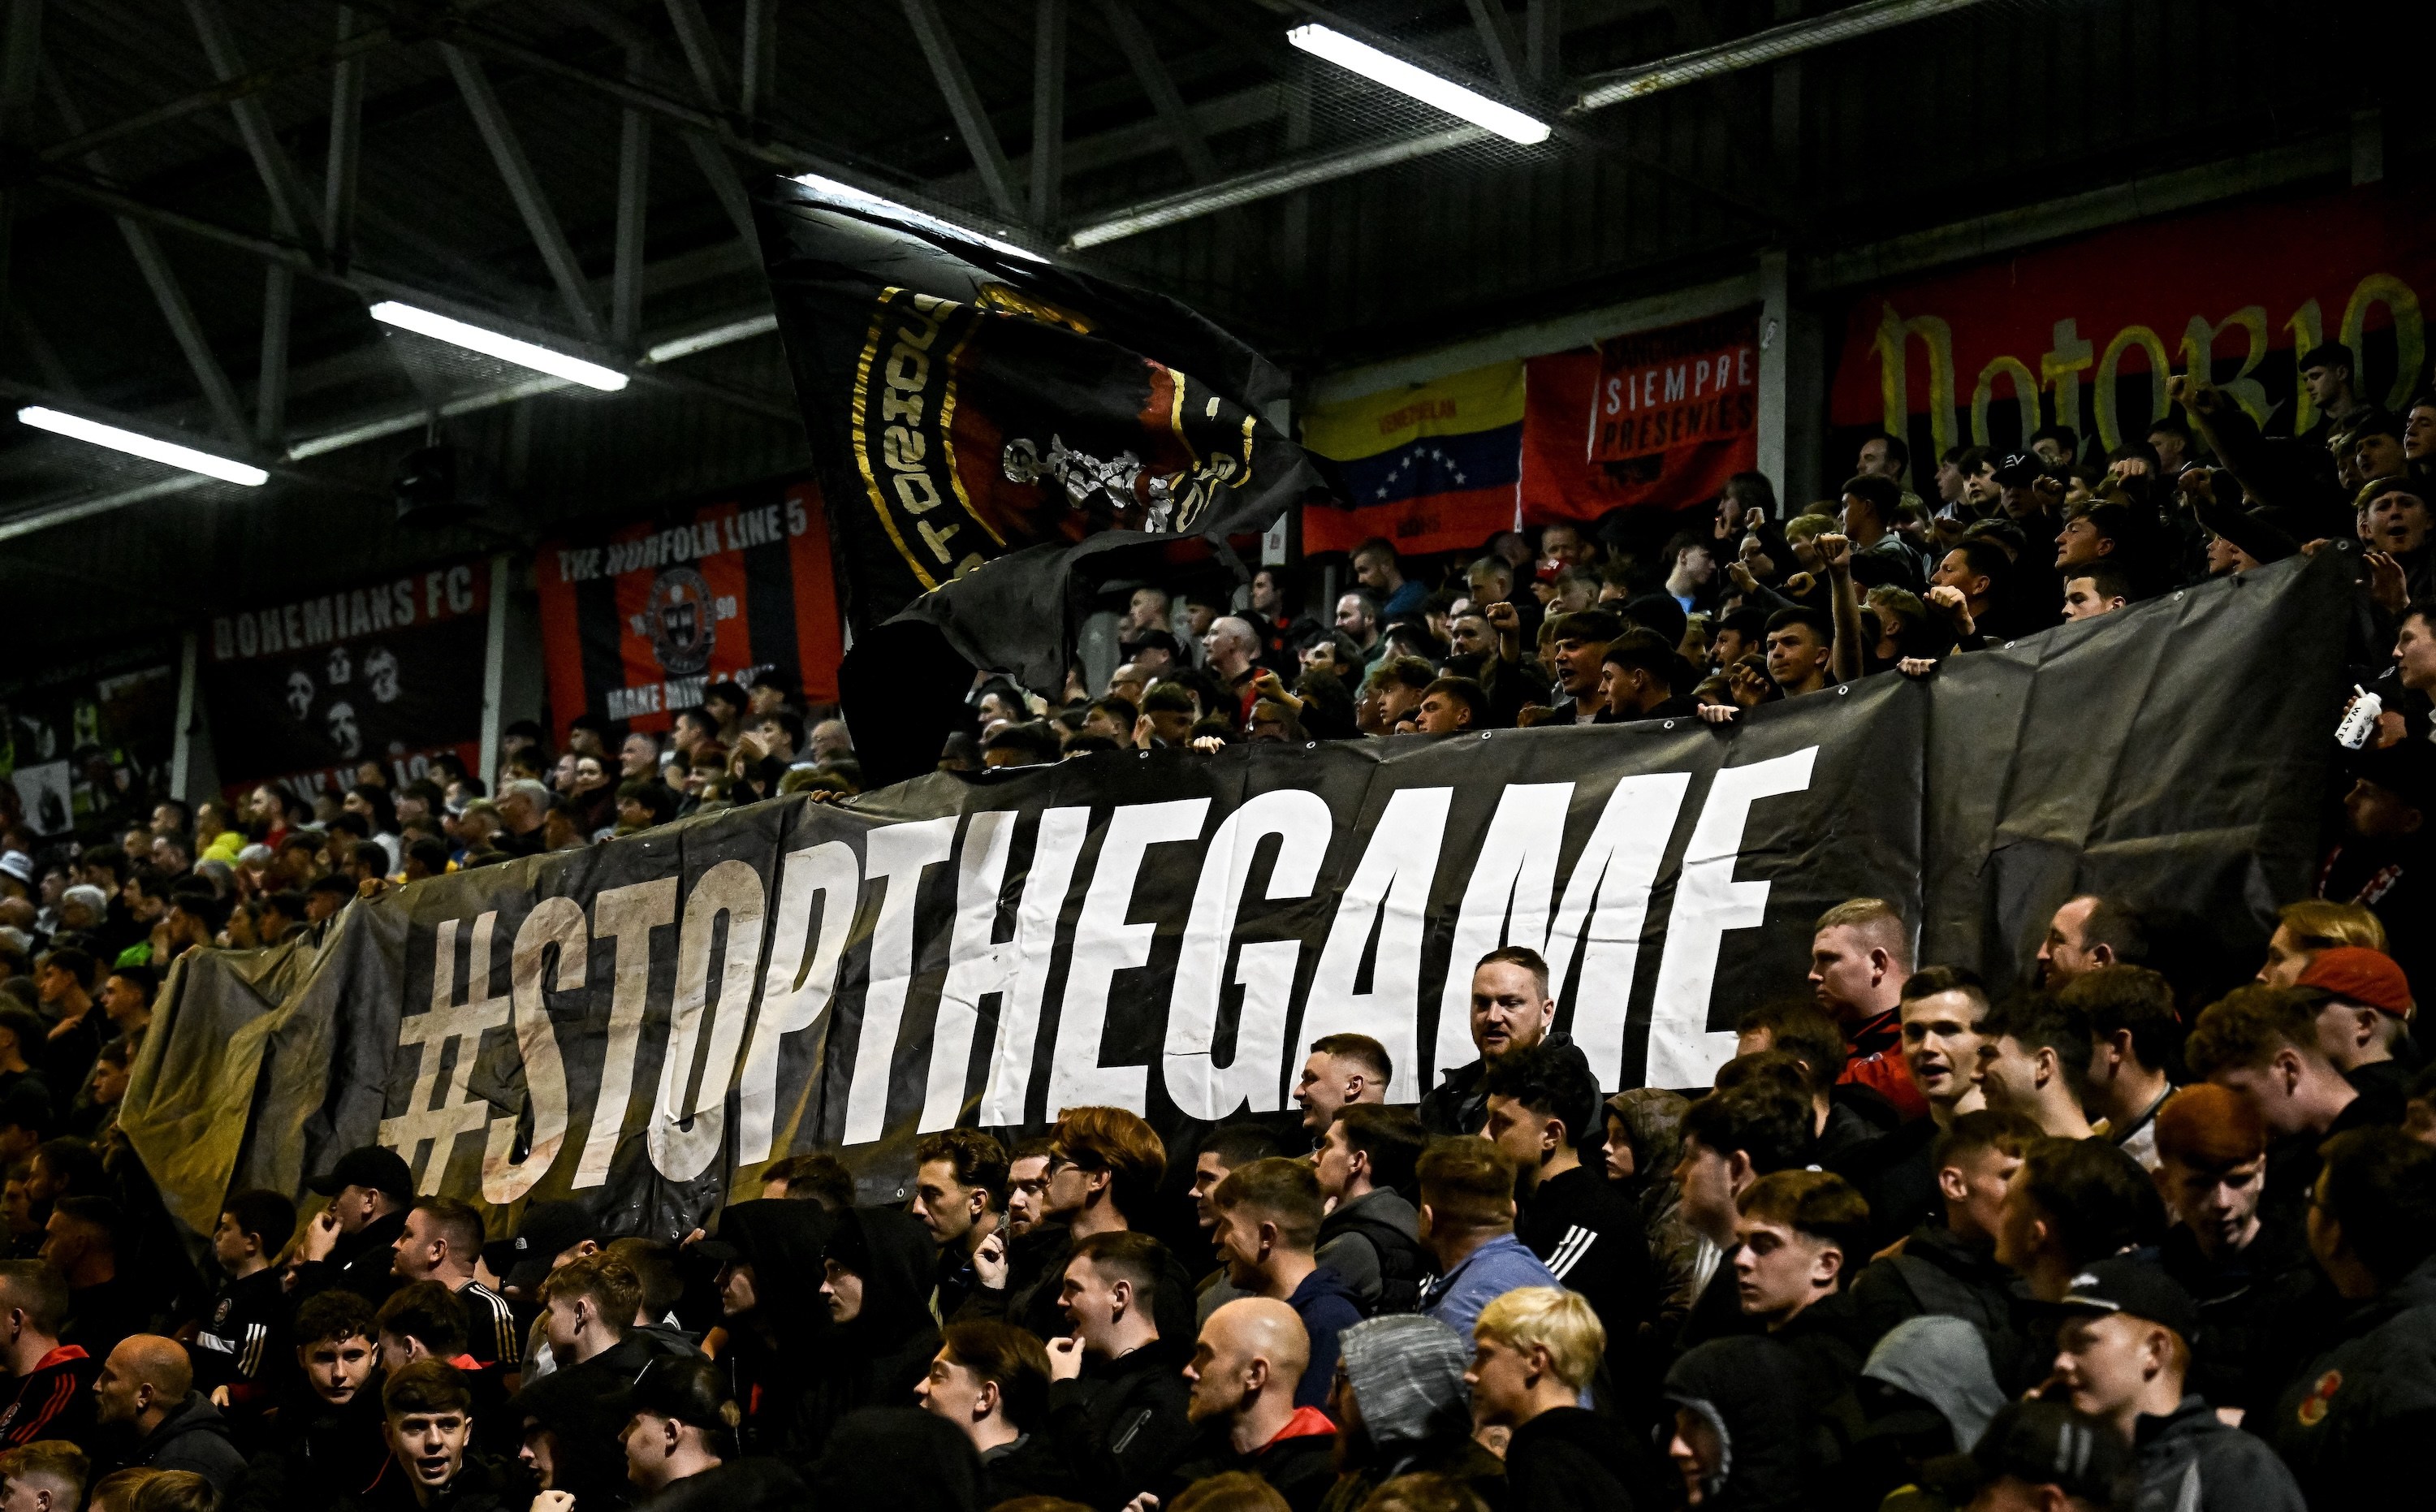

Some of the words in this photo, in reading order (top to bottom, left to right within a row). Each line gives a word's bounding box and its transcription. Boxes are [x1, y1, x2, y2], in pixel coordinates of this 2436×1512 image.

[1605, 346, 1752, 416] SIEMPRE
[1601, 392, 1754, 454] PRESENTES
[558, 547, 602, 583] THE
[603, 520, 721, 577] NORFOLK
[724, 503, 783, 552] LINE
[785, 498, 808, 537] 5
[213, 577, 417, 660] BOHEMIANS
[425, 565, 474, 620] FC
[607, 685, 661, 722] MAKE
[376, 745, 1820, 1205] #STOPTHEGAME
